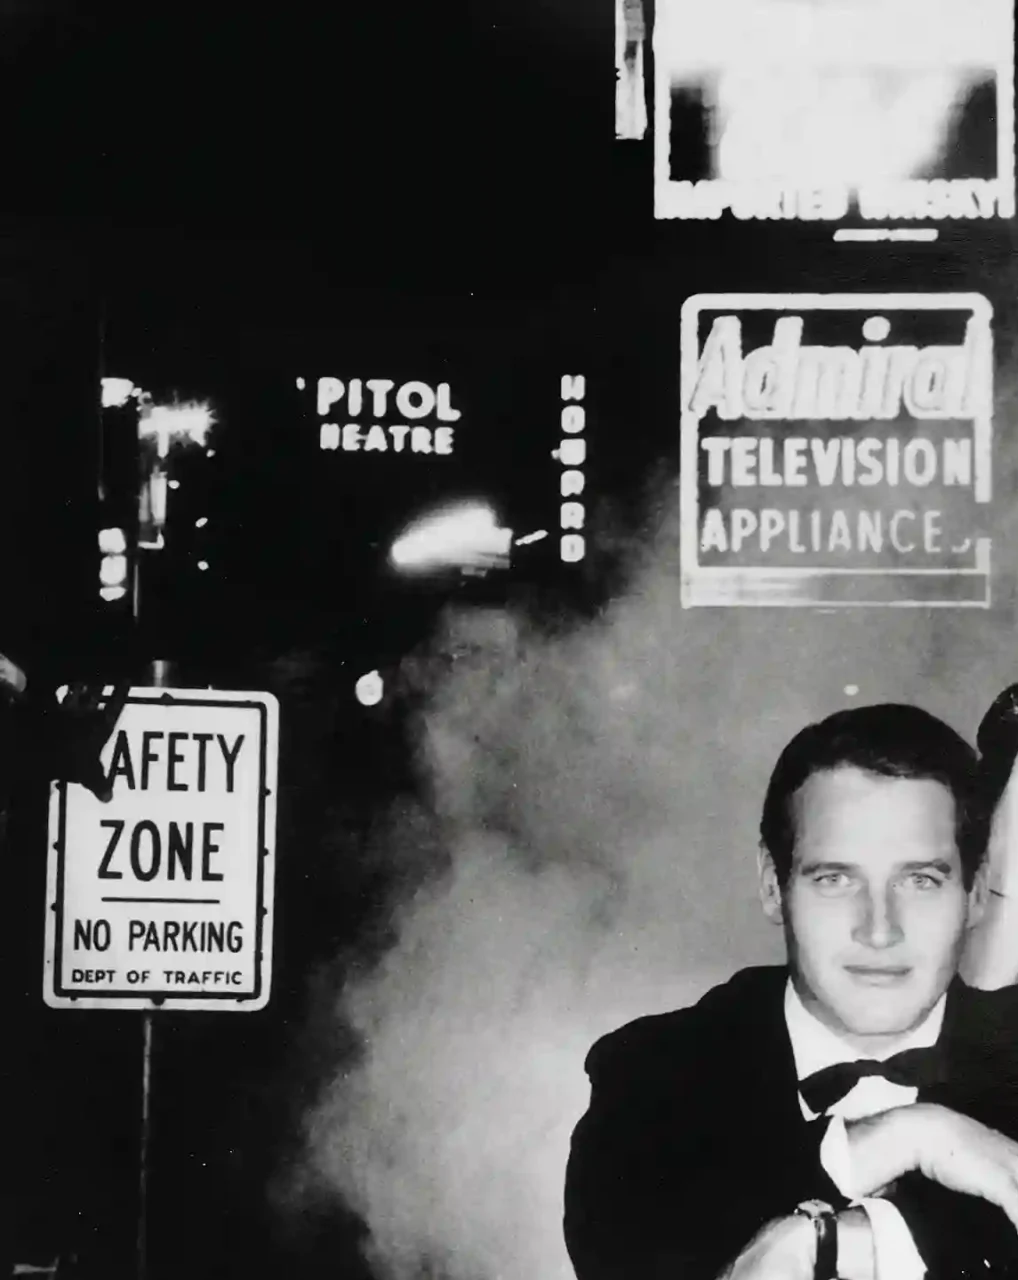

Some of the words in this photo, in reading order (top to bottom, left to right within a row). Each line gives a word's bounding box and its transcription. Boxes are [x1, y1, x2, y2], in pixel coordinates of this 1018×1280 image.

[688, 315, 992, 420] Admiral
[296, 376, 462, 421] PITOL
[701, 437, 972, 486] TELEVISION
[110, 729, 246, 793] AFETY
[97, 819, 225, 882] ZONE
[73, 918, 112, 952] NO
[128, 919, 244, 953] PARKING
[71, 969, 117, 984] DEPT
[126, 969, 151, 984] OF
[163, 970, 244, 985] TRAFFIC
